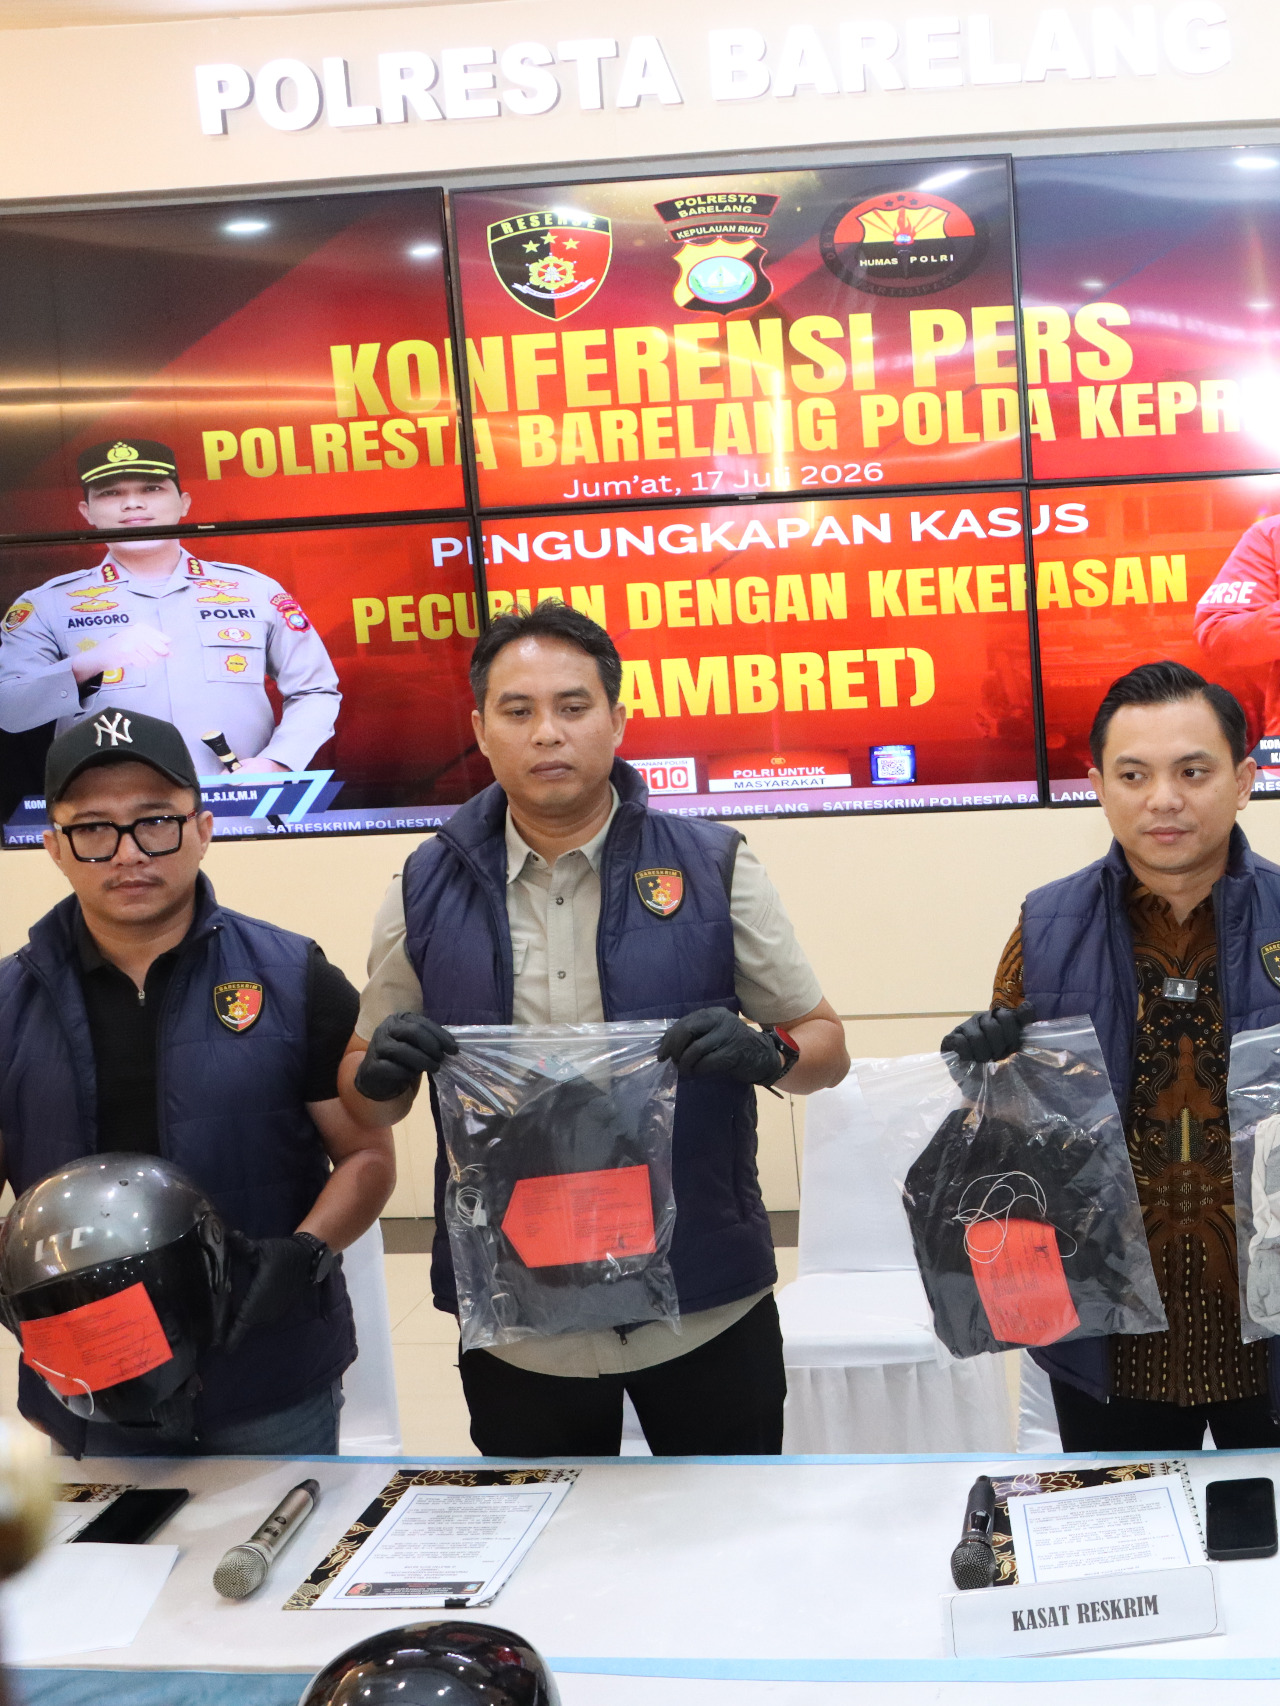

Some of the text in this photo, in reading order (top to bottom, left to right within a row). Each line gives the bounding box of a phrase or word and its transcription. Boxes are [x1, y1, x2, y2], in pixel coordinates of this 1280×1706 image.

[195, 3, 1232, 135] POLRESTA BARELANG
[675, 194, 757, 209] POLRESTA
[678, 204, 752, 218] BARELANG
[676, 225, 762, 240] KEPULAUAN RIAU
[859, 254, 954, 267] HUMAS POLRI
[330, 313, 875, 418] KONFERENSI
[910, 302, 1133, 388] PERS
[202, 379, 1242, 480] POLRESTA BARELANG POLDA KEPR
[563, 462, 884, 499] Jum'at, 17 Juli 2026
[432, 512, 892, 568] PENGUNGKAPAN
[626, 571, 848, 630] DENGAN
[1200, 582, 1257, 605] ERSE
[67, 613, 130, 629] ANGGORO
[200, 608, 256, 621] POLRI
[619, 647, 936, 719] AMBRET)
[639, 769, 687, 787] 10
[733, 766, 825, 778] POLRI UNTUK
[734, 778, 827, 789] MASYARAKAT
[24, 800, 47, 810] KOM
[667, 806, 717, 818] RESTA
[722, 803, 808, 815] BARELANG
[822, 797, 925, 811] SATRESKRIM
[929, 793, 1014, 807] POLRESTA
[1017, 790, 1098, 805] BALANG
[213, 826, 255, 836] LANG
[267, 820, 362, 834] SATRESKRIM
[366, 817, 443, 830] POLRESTA
[1012, 1594, 1159, 1631] KASAT RESKRIM
